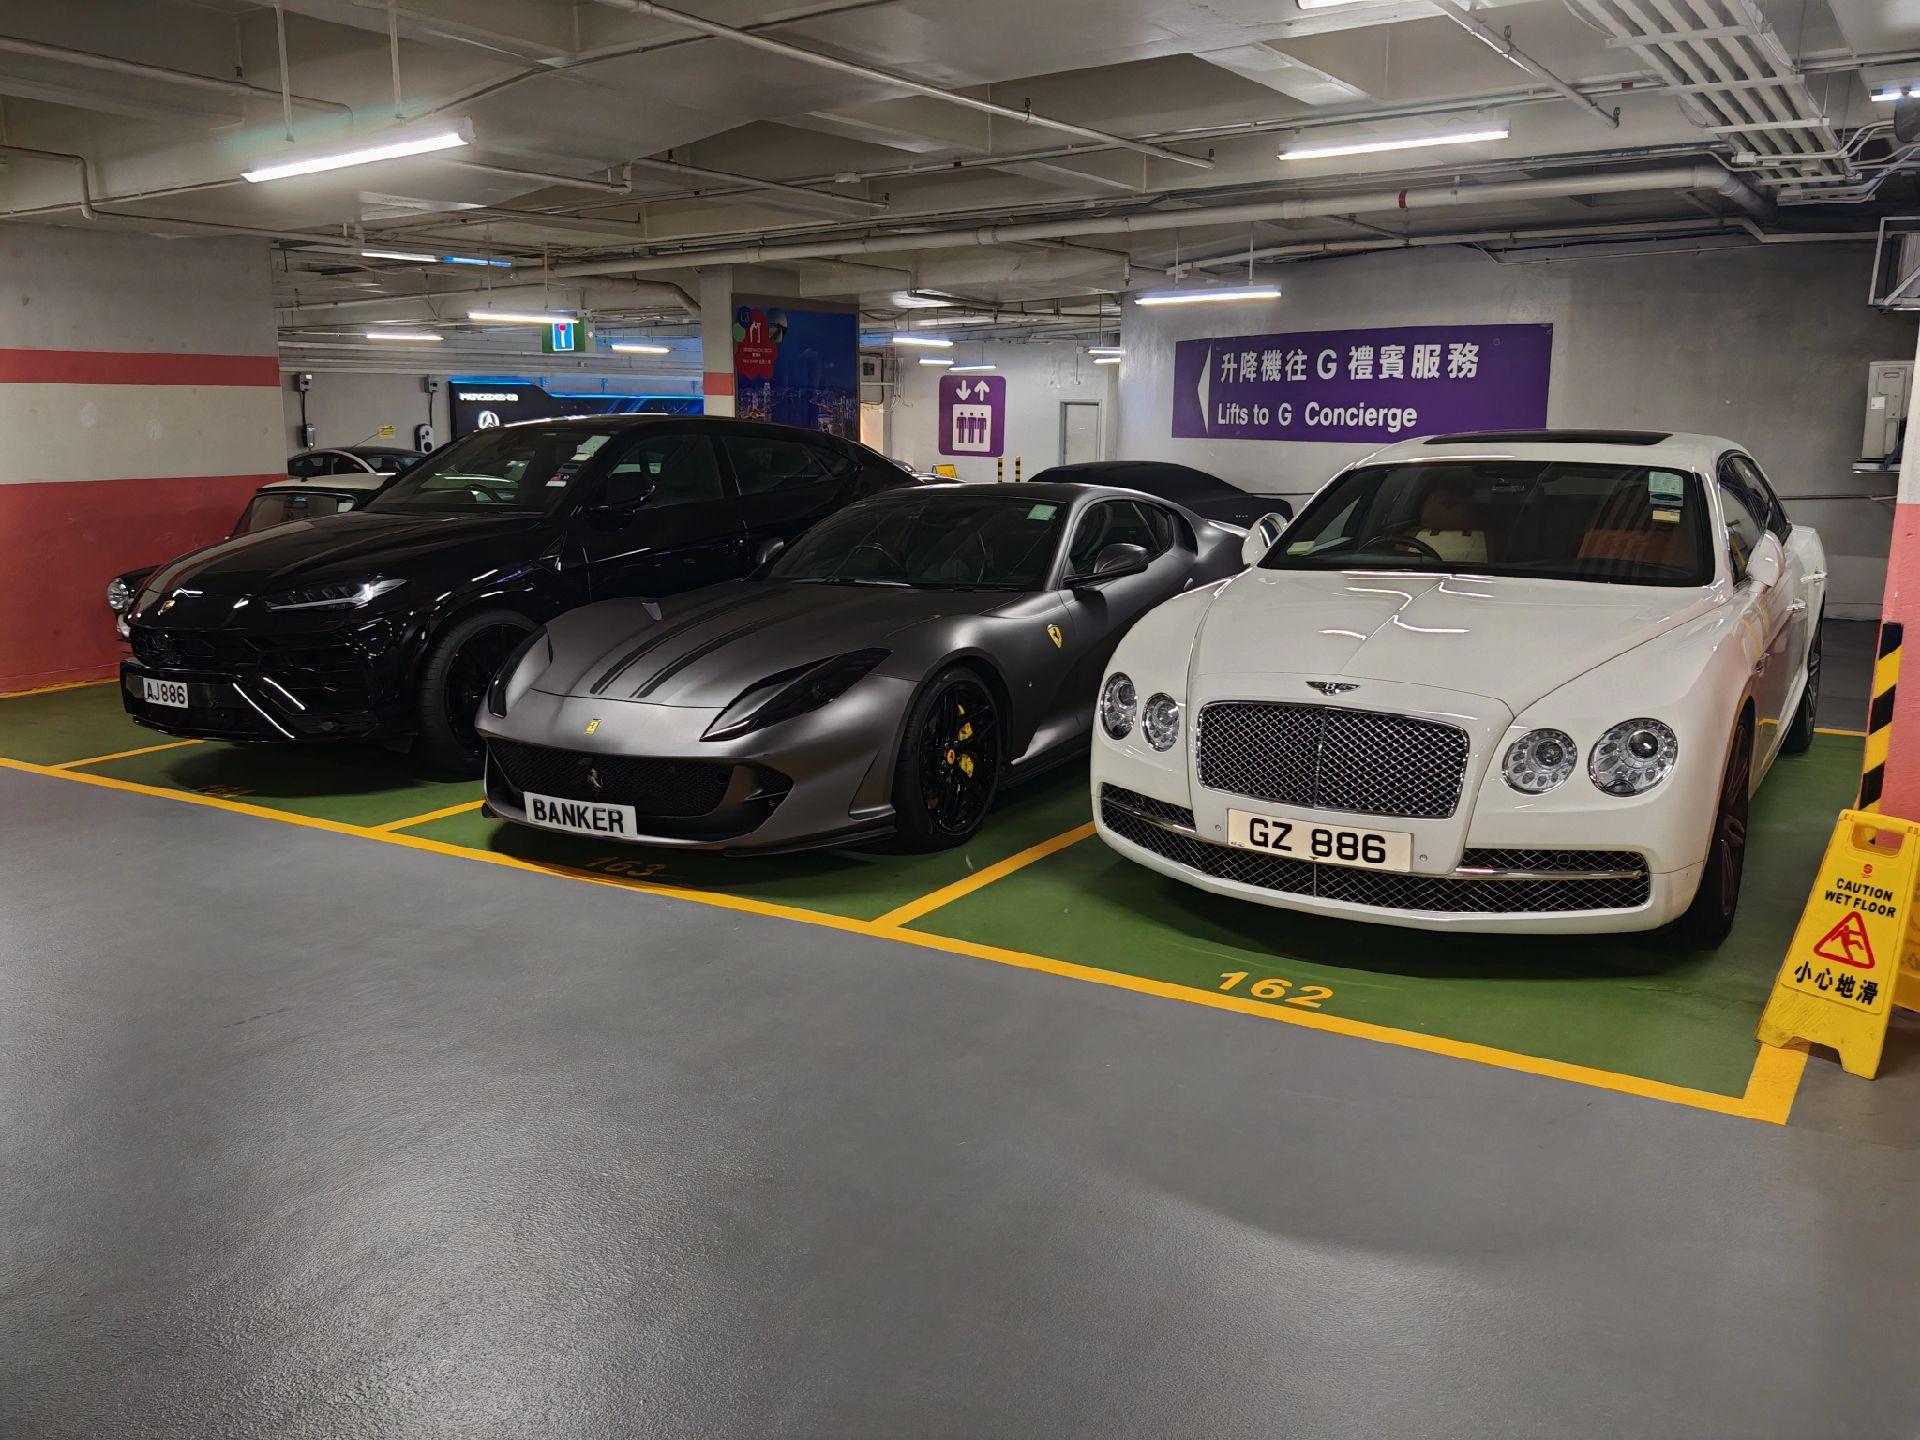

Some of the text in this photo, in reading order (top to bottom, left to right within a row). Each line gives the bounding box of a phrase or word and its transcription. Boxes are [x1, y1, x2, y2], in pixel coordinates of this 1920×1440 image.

[1220, 342, 1480, 384] 升降機往 G 禮賓服務
[1217, 401, 1418, 433] Lifts to G Concierge
[532, 797, 625, 834] BANKER
[1249, 817, 1386, 864] GZ 886
[586, 856, 667, 877] 163
[1825, 890, 1897, 918] WET FLOOR
[1836, 878, 1893, 902] CAUTION
[1218, 971, 1334, 1009] 162
[1794, 961, 1879, 1006] 小心地滑
